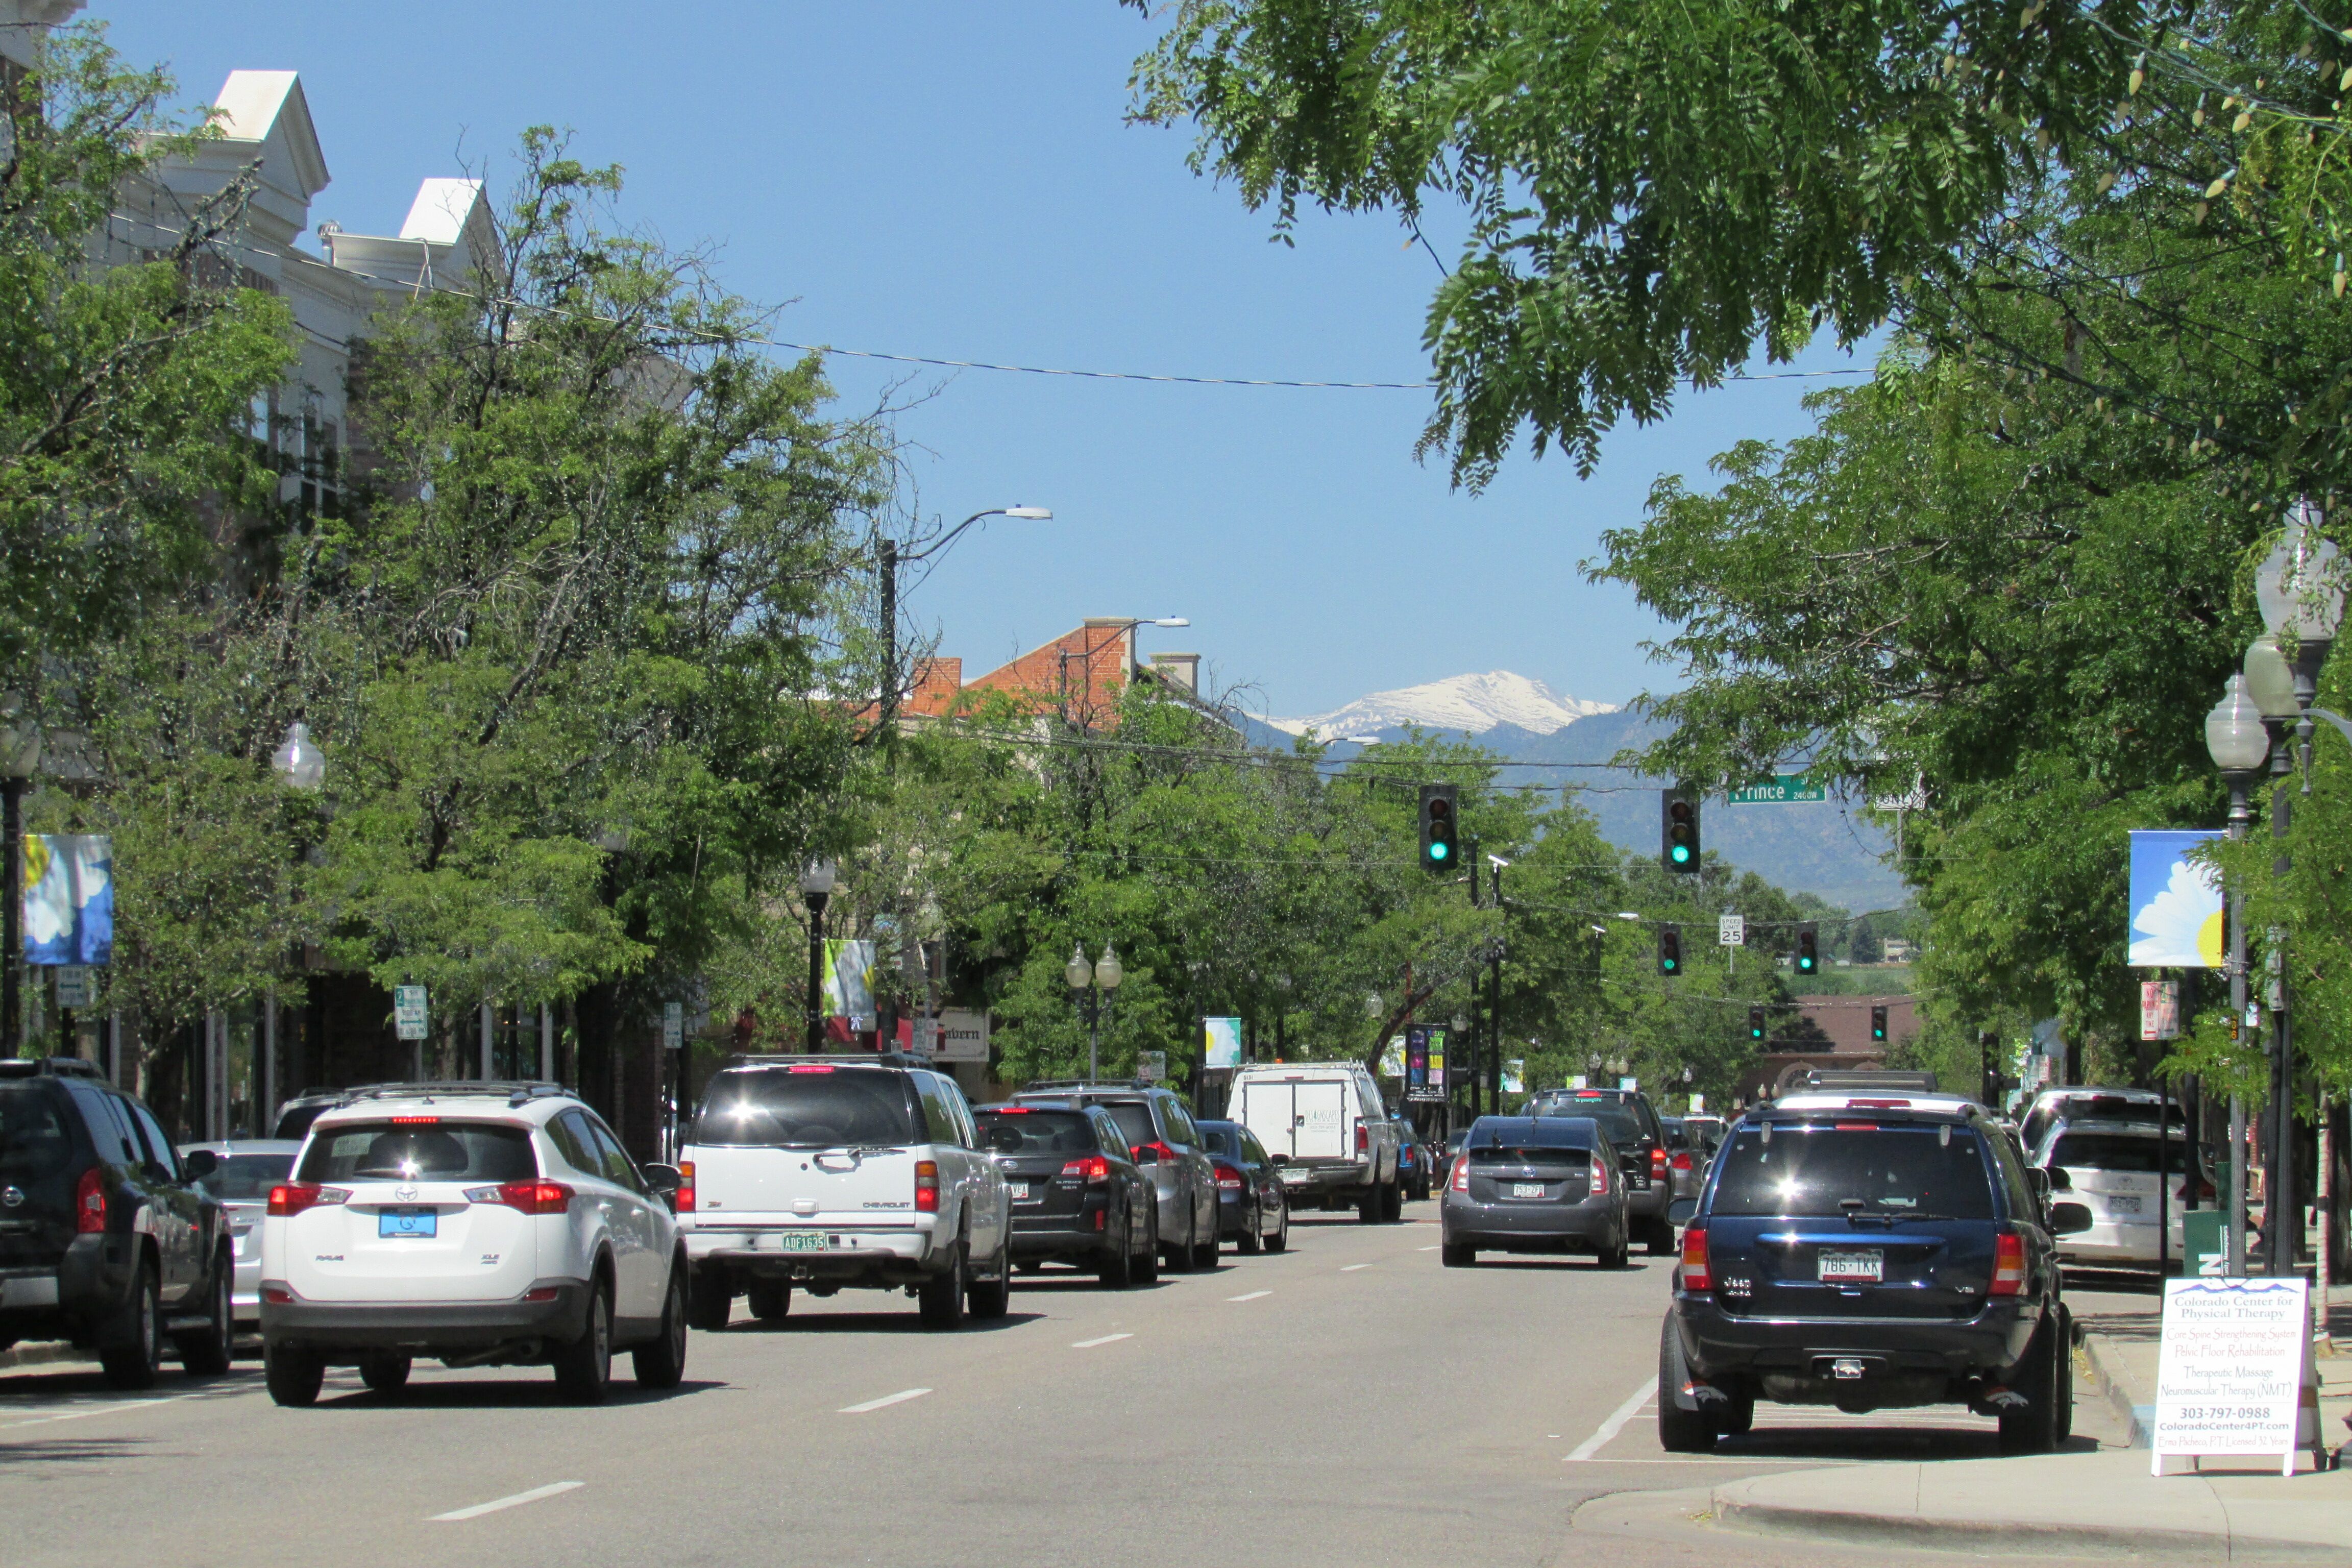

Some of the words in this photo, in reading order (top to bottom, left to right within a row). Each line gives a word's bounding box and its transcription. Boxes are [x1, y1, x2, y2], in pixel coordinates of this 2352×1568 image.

[1722, 931, 1741, 942] 25
[939, 1024, 979, 1039] avern
[2174, 1297, 2229, 1307] Colorado
[2233, 1296, 2273, 1306] Center
[2277, 1296, 2293, 1306] for
[2180, 1308, 2231, 1321] Physical
[2235, 1308, 2285, 1320] Therapy
[2166, 1328, 2187, 1340] Core
[2188, 1328, 2211, 1343] Spine
[2212, 1328, 2266, 1342] Strengthening
[2268, 1327, 2296, 1341] System
[2175, 1344, 2198, 1358] Pelvic
[2201, 1344, 2225, 1358] Floor
[2227, 1343, 2285, 1358] Rehabilitation
[2184, 1365, 2233, 1382] Therapeutic
[2235, 1366, 2273, 1381] Massage
[2161, 1382, 2218, 1397] Neuromuscular
[2220, 1383, 2255, 1400] Therapy
[2257, 1381, 2292, 1398] (NMT)
[2180, 1408, 2270, 1419] 303-797-0988
[2160, 1422, 2289, 1431] ColoradoCenter4PT.com
[2158, 1436, 2177, 1448] Erma
[2226, 1435, 2256, 1446] Licensed
[2258, 1436, 2267, 1446] 32
[2270, 1435, 2288, 1446] Years
